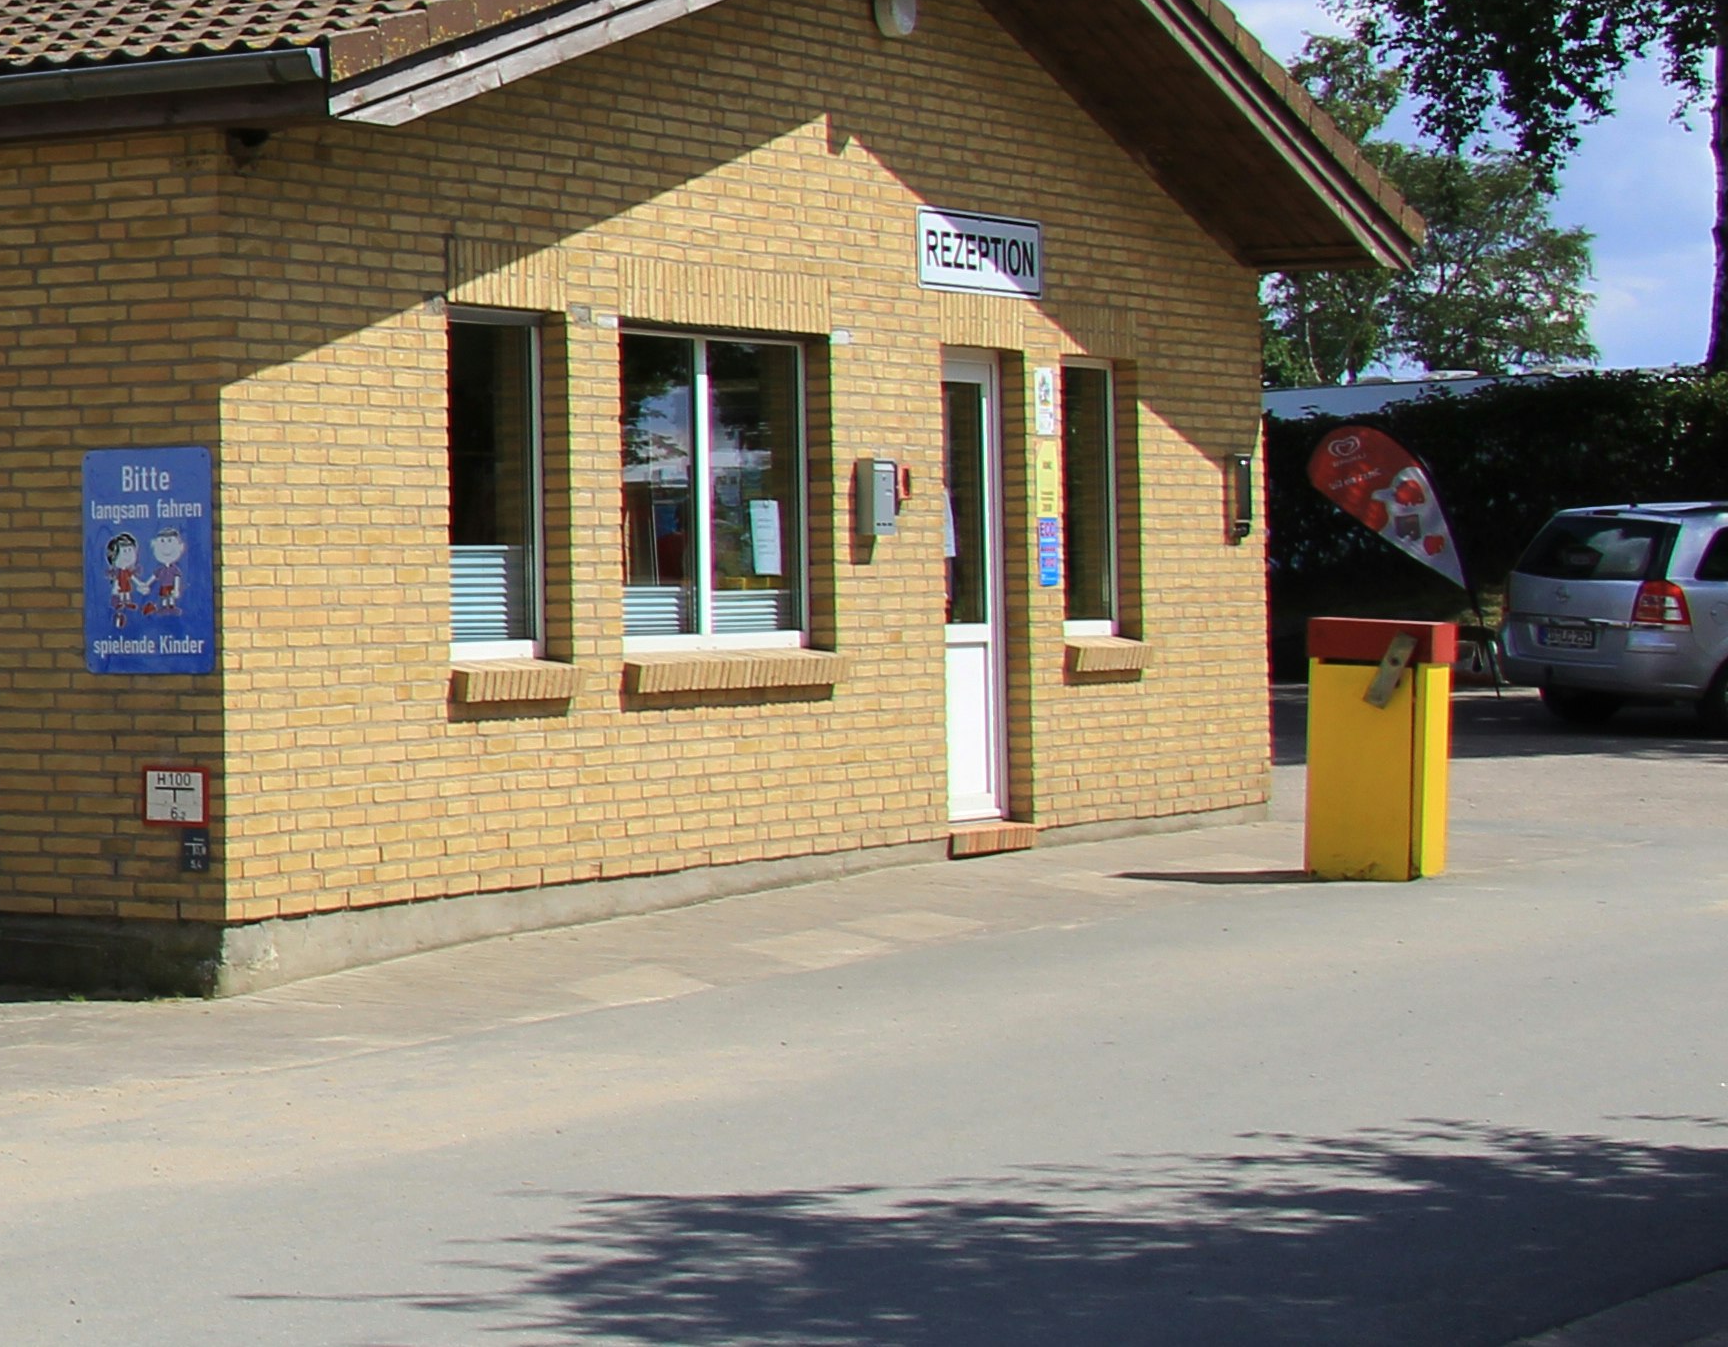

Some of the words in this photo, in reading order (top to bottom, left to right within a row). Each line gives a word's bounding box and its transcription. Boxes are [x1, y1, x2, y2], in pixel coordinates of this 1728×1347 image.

[926, 228, 1035, 278] REZEPTION
[121, 465, 171, 492] Bitte
[91, 500, 150, 525] langsam
[156, 498, 203, 518] fahren
[93, 635, 156, 660] spielende
[159, 634, 205, 654] Kinder
